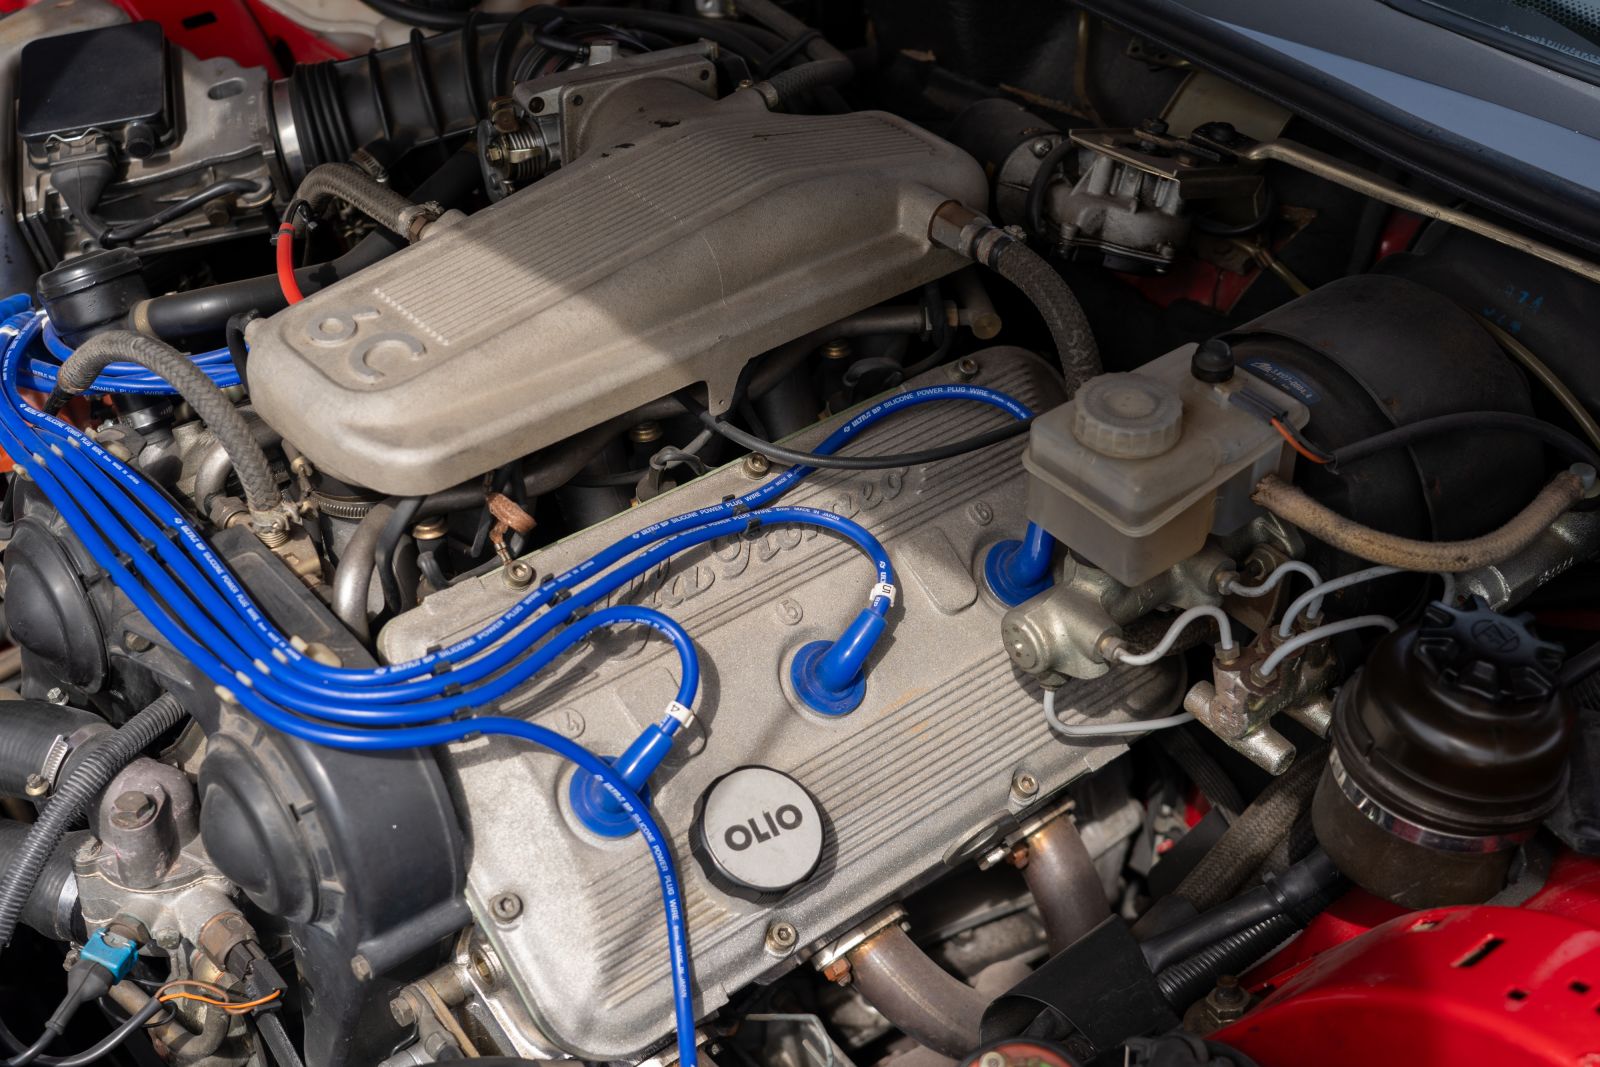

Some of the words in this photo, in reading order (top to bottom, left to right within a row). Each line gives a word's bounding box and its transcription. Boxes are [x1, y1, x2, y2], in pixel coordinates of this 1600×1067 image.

[883, 393, 914, 409] SILICONE
[916, 387, 943, 398] POWER
[969, 388, 988, 397] WIRE
[65, 425, 82, 438] POWER
[80, 436, 93, 447] PLUG
[672, 512, 699, 524] SILICONE
[700, 505, 724, 515] POWER
[725, 499, 743, 508] PLUG
[744, 492, 762, 502] WIRE
[732, 512, 751, 521] PLUG
[752, 508, 773, 516] WIRE
[822, 512, 841, 521] JAPAN
[881, 584, 892, 594] 5
[236, 594, 250, 608] PLUG
[477, 619, 505, 640] POWER
[505, 605, 524, 621] PLUG
[632, 813, 656, 843] SILICONE
[723, 803, 803, 852] OLIO
[652, 845, 669, 872] POWER
[664, 875, 675, 896] PLUG
[669, 899, 679, 921] WIRE
